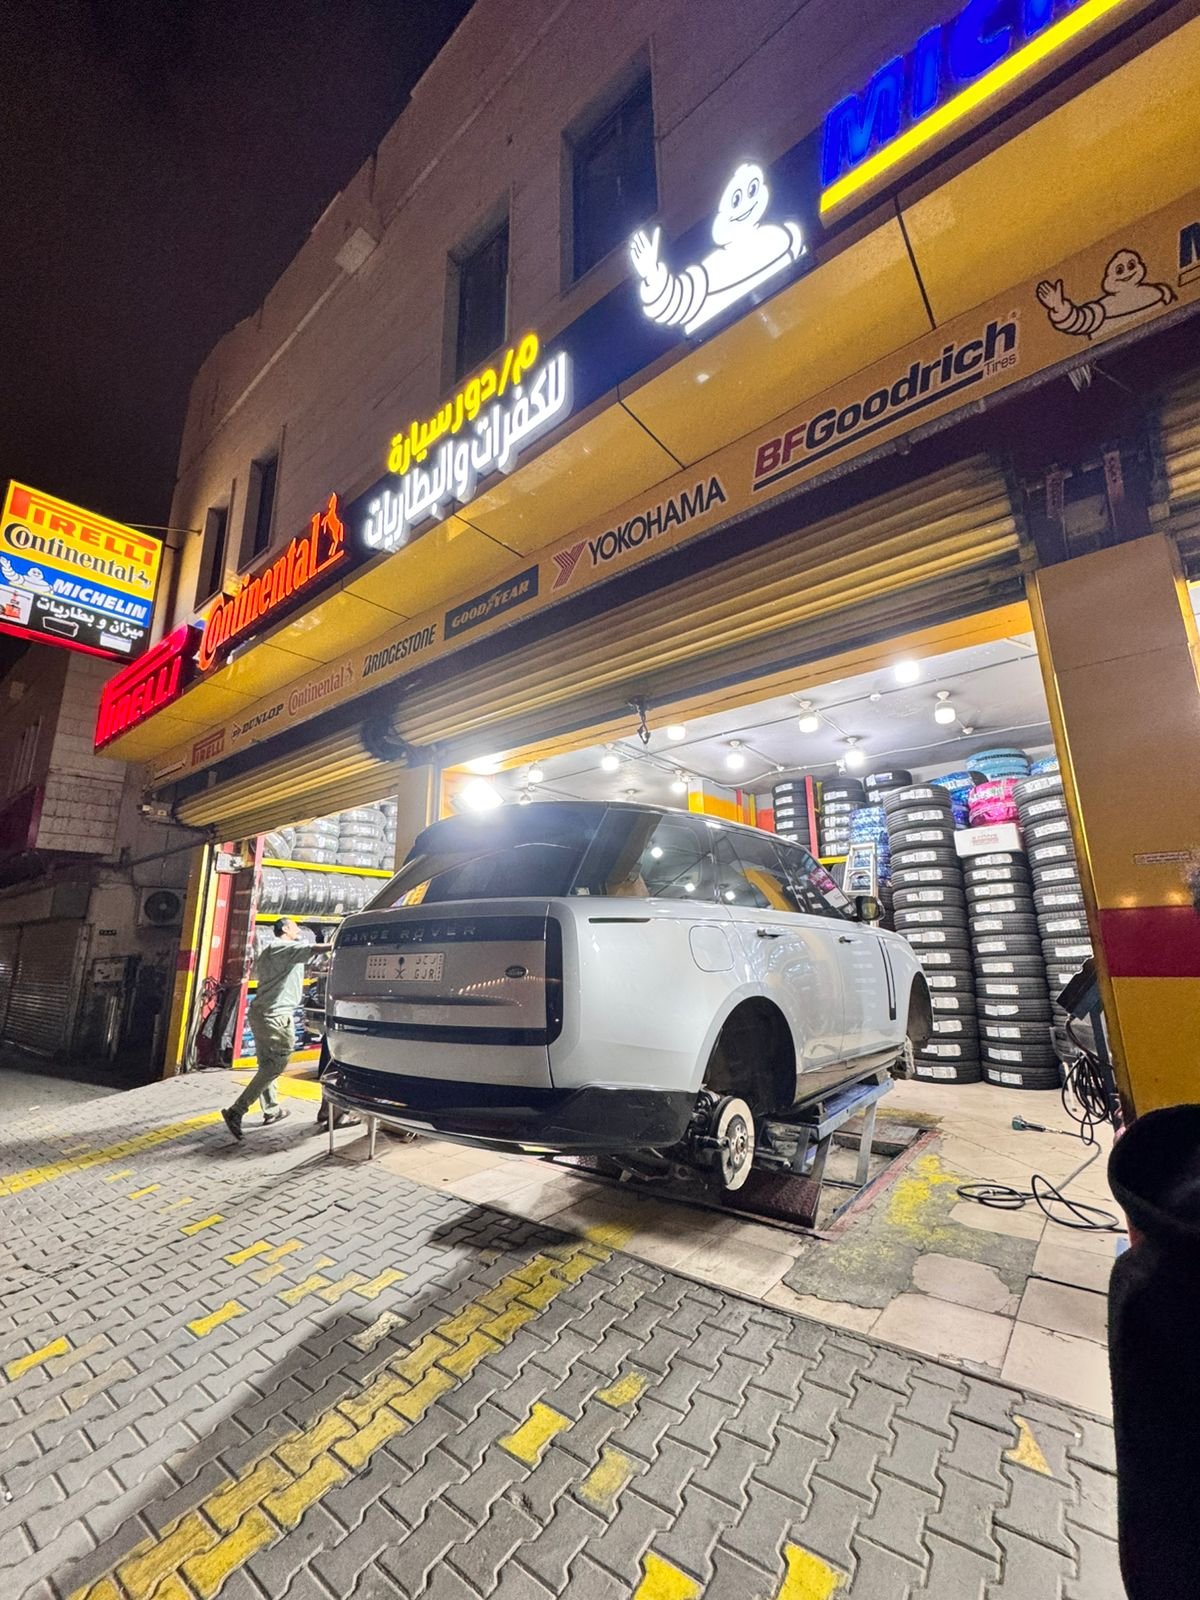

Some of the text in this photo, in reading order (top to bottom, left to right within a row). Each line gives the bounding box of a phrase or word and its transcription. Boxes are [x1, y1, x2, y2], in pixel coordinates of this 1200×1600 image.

[984, 354, 1017, 376] Tires
[755, 321, 1017, 478] BFGoodrich
[363, 352, 568, 551] للكفرات والبطاريات
[9, 486, 158, 566] PIRELLI
[588, 477, 726, 566] YOKOHAMA
[4, 522, 135, 584] Continental
[36, 595, 144, 640] ميزان و بطاريات
[53, 578, 149, 619] MICHELIN
[200, 513, 321, 671] Continental
[451, 579, 529, 630] GOODYEAR
[362, 623, 438, 678] BRIDGESTONE
[94, 624, 189, 747] PIRELLI
[288, 666, 345, 717] Continental
[241, 703, 285, 734] DUNLOP
[191, 728, 226, 767] PIRELLI
